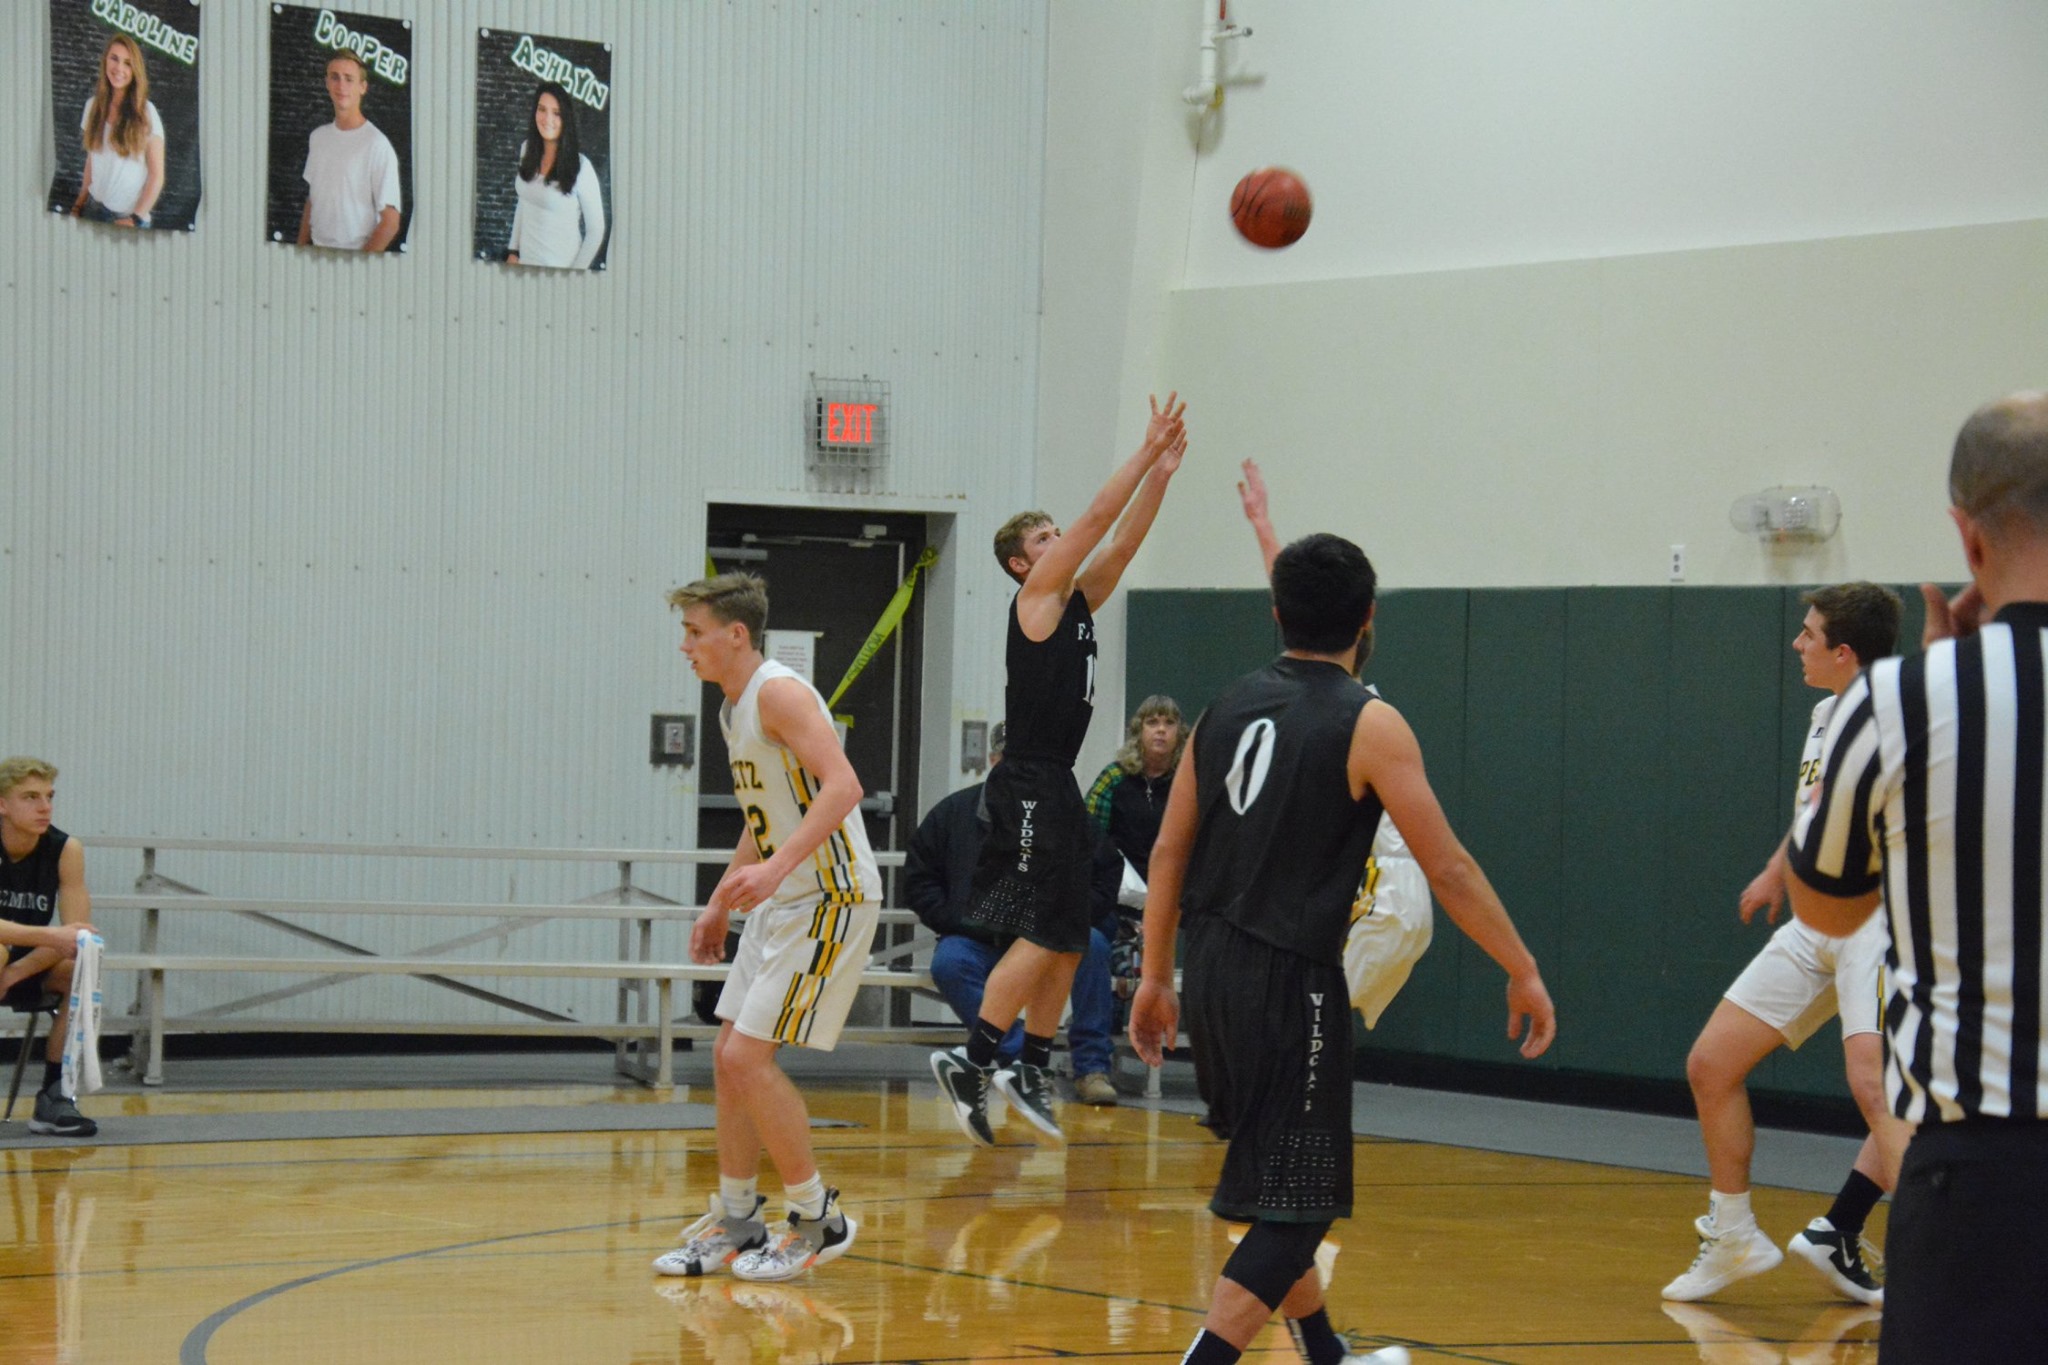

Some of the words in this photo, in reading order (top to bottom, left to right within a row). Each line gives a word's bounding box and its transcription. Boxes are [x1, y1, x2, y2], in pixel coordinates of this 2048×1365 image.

[315, 9, 407, 84] COOPER
[511, 35, 609, 110] ASHLYN
[828, 402, 877, 443] EXIT
[1225, 718, 1276, 816] 0
